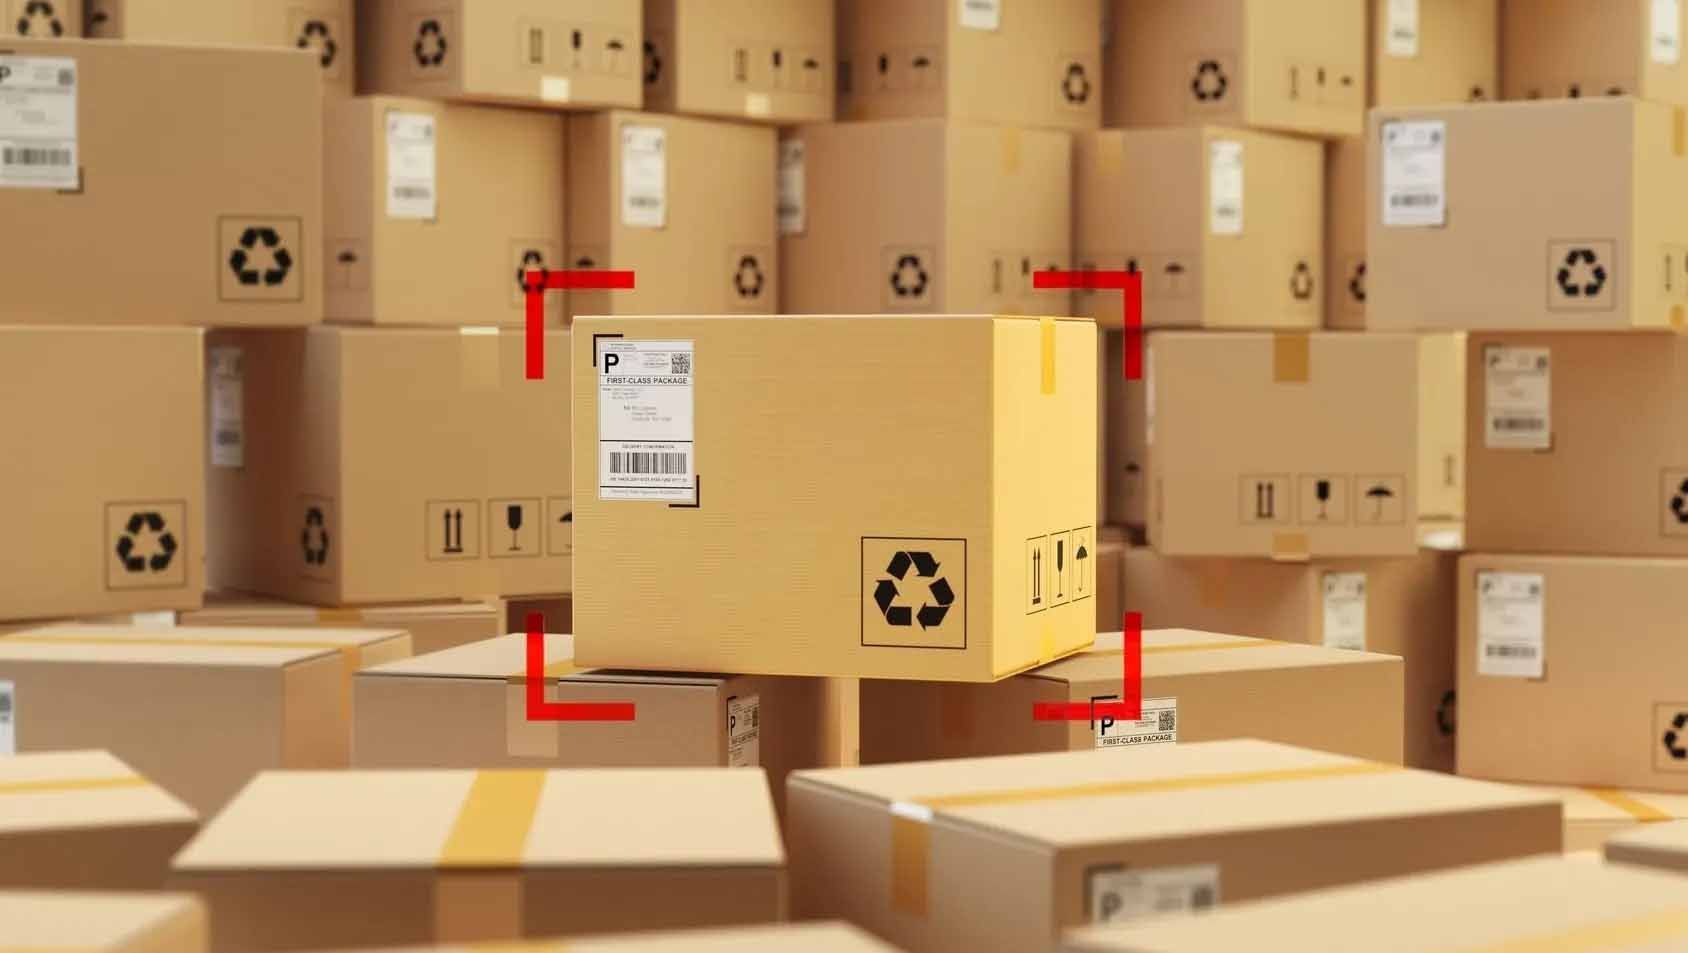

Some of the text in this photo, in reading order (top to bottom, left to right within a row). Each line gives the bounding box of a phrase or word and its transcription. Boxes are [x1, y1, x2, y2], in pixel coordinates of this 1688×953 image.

[604, 353, 619, 374] P
[607, 377, 688, 385] FIRST-CLASS PACKAGE
[1101, 716, 1114, 736] P
[1103, 733, 1172, 745] FIRST-CLASS PACKAGE
